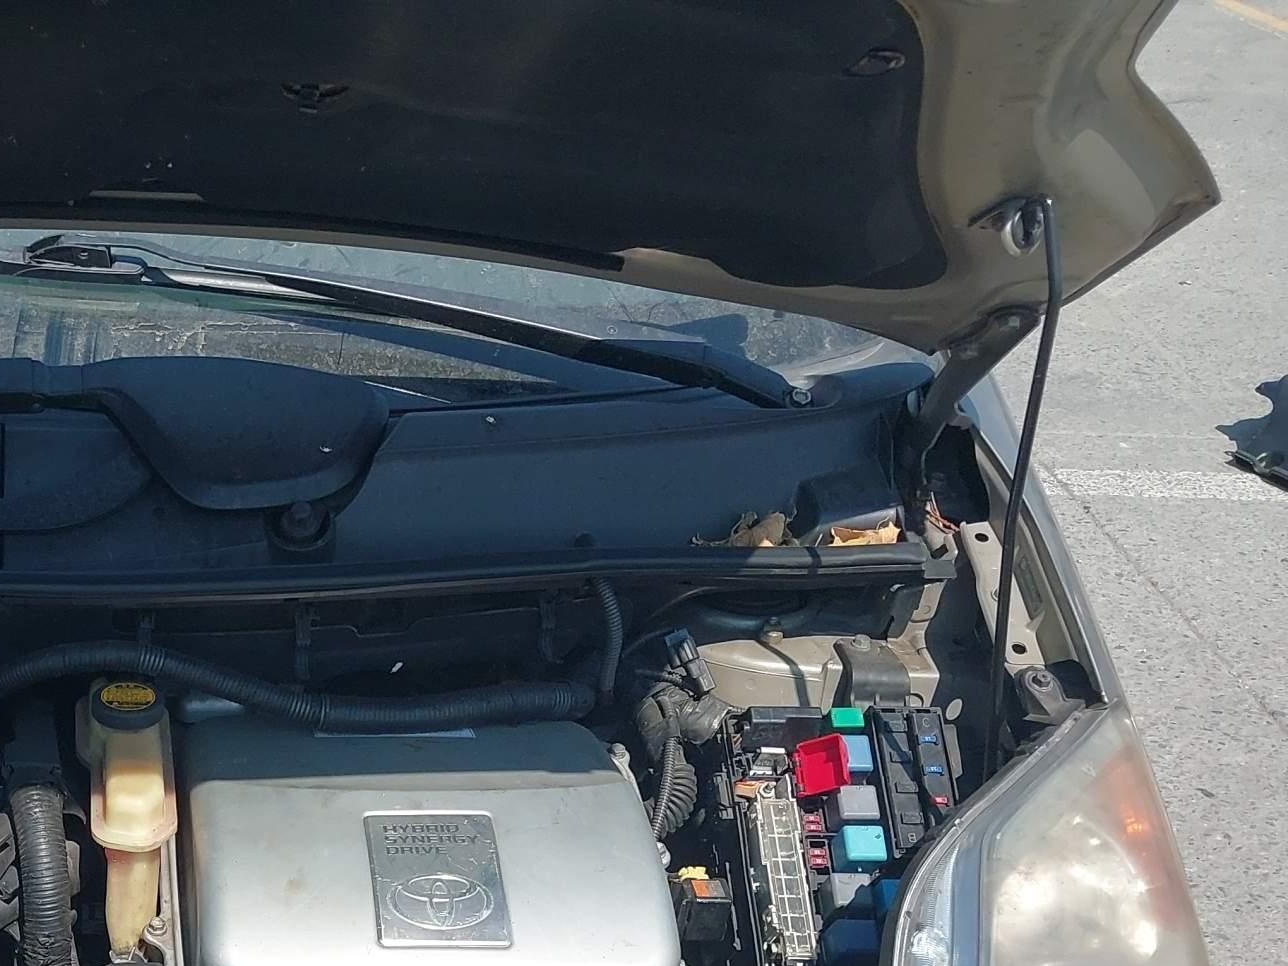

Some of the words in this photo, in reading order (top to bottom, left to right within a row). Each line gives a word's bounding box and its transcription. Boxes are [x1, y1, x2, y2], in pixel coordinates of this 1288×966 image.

[382, 823, 460, 833] HYBRID
[384, 834, 480, 844] SYNERGY
[385, 845, 448, 855] DRIVE
